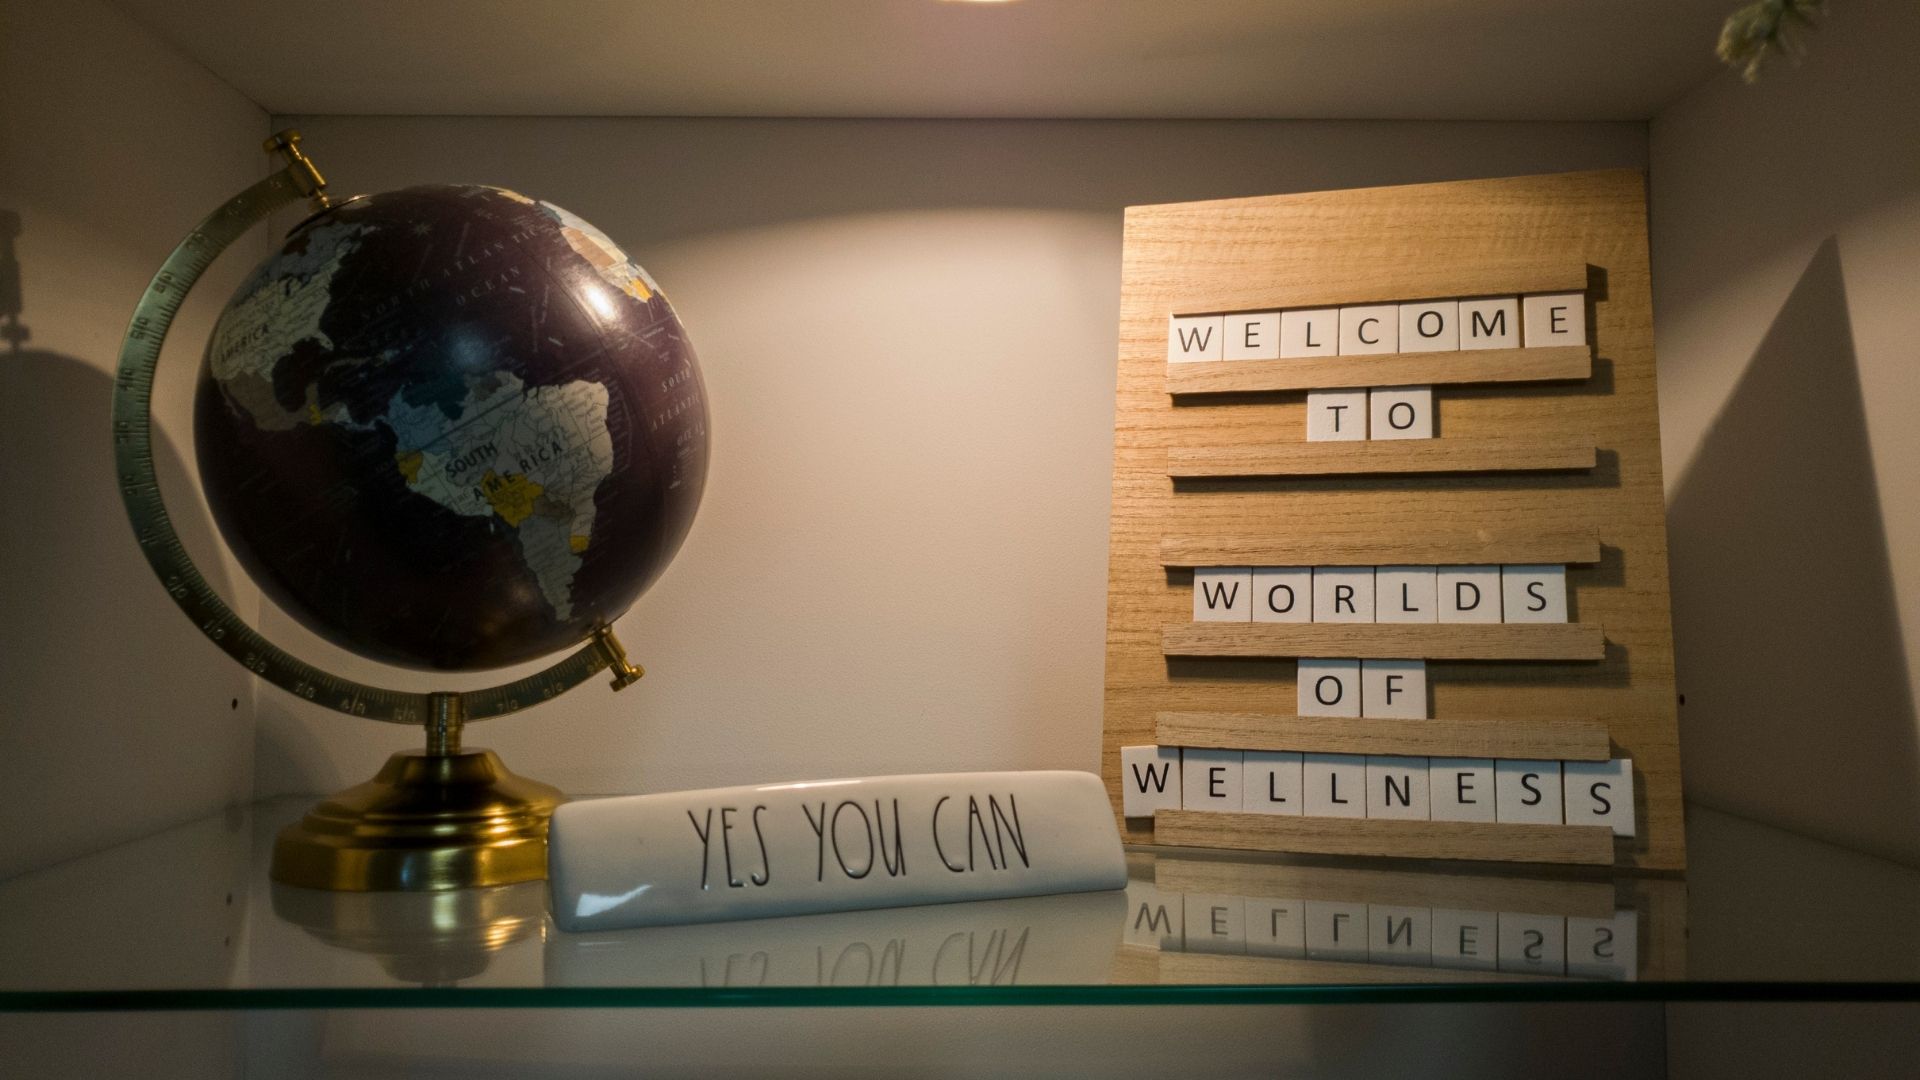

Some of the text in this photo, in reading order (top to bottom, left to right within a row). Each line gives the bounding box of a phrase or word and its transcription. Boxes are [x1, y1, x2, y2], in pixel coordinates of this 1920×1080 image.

[1177, 306, 1569, 353] WELCOME
[1327, 402, 1415, 433] TO
[445, 442, 498, 479] SOUTH
[473, 441, 563, 501] AMERICA
[1202, 581, 1547, 614] WORLDS
[1315, 675, 1404, 705] OF
[1132, 762, 1612, 815] WELLNESS
[687, 793, 1029, 890] YES YOU CAN
